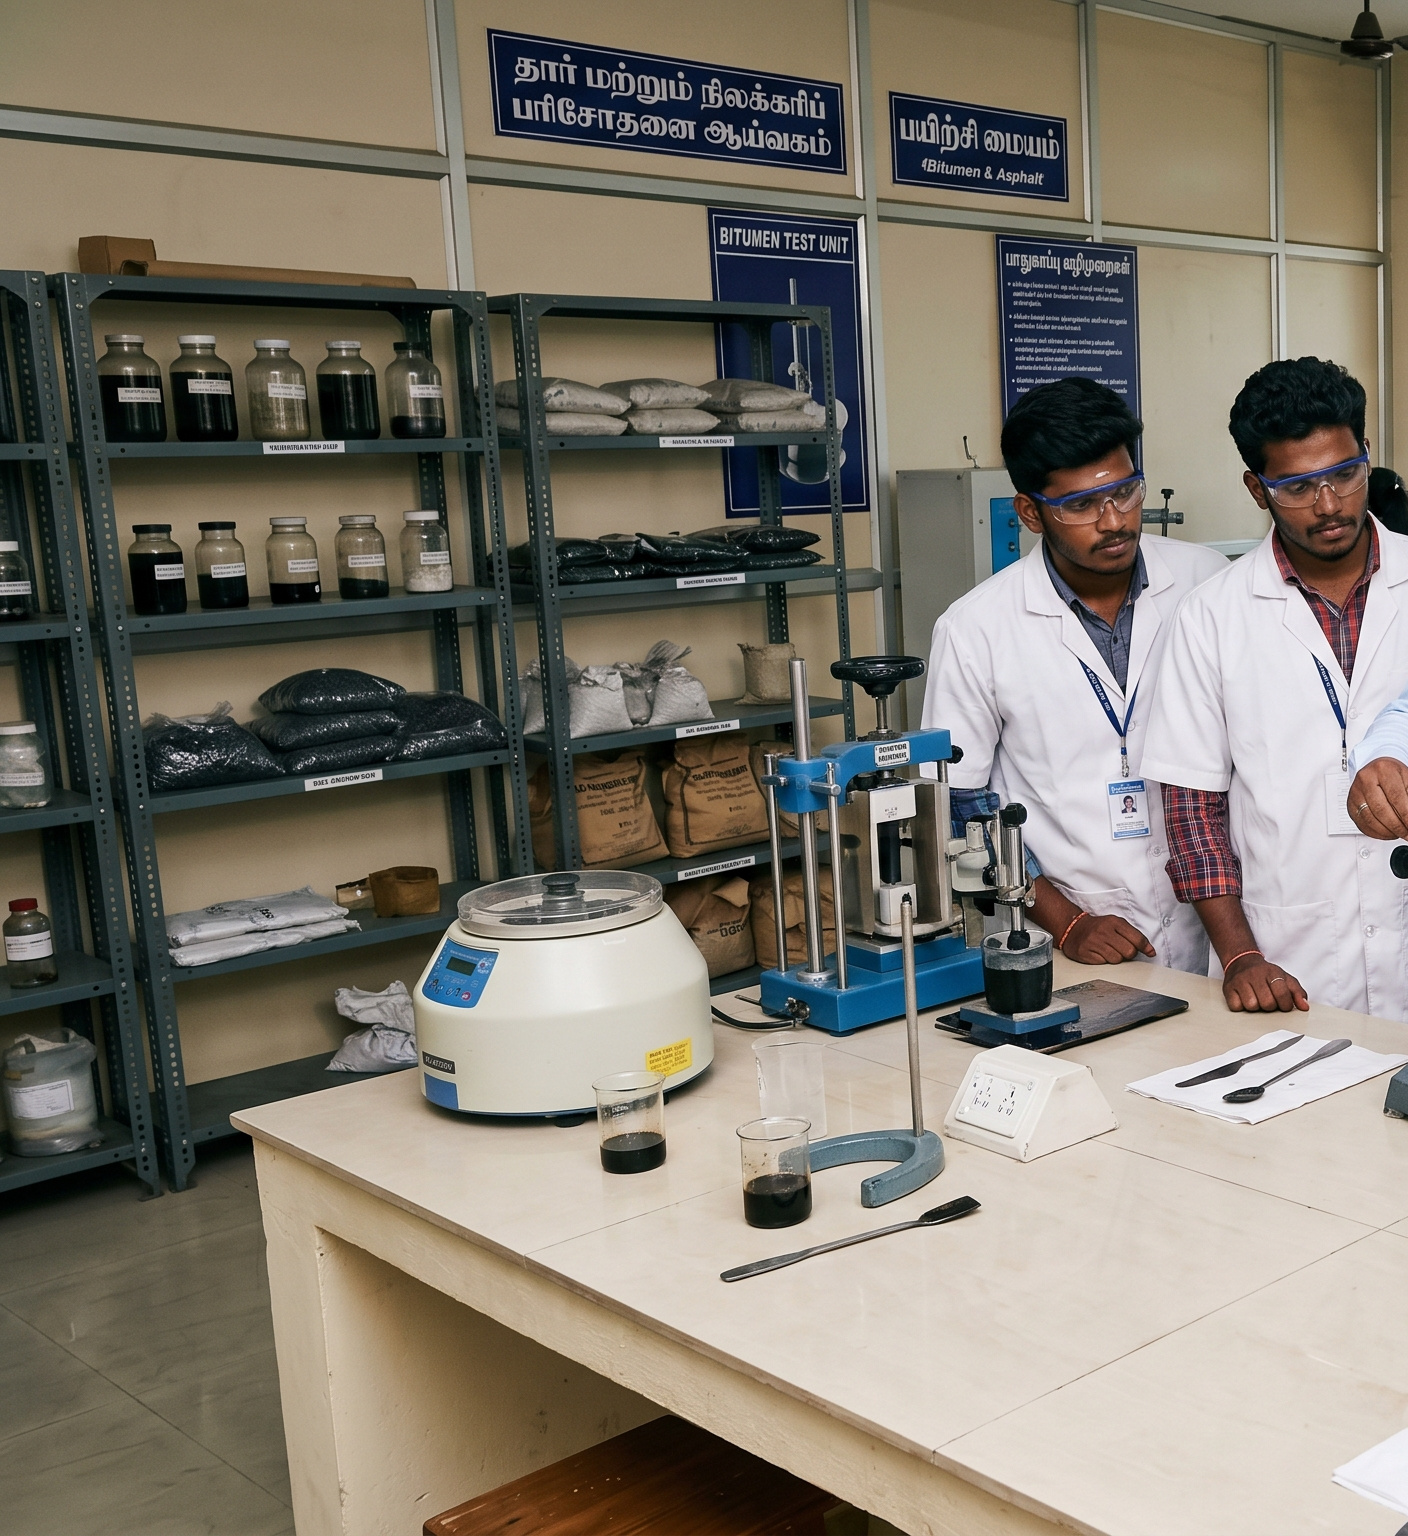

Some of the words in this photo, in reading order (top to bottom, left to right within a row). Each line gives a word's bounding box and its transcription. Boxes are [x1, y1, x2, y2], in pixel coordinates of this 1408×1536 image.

[514, 53, 577, 85] தார்
[586, 62, 693, 105] மற்றும்
[701, 78, 826, 120] நிலக்கரிப்
[512, 93, 697, 140] பரிசோதனை
[704, 119, 832, 157] ஆய்வகம்
[900, 113, 978, 154] பயிற்சி
[984, 129, 1060, 160] மையம்
[984, 166, 993, 180] &
[720, 227, 780, 249] BITUMEN
[783, 232, 816, 251] TEST
[819, 234, 849, 254] UNIT
